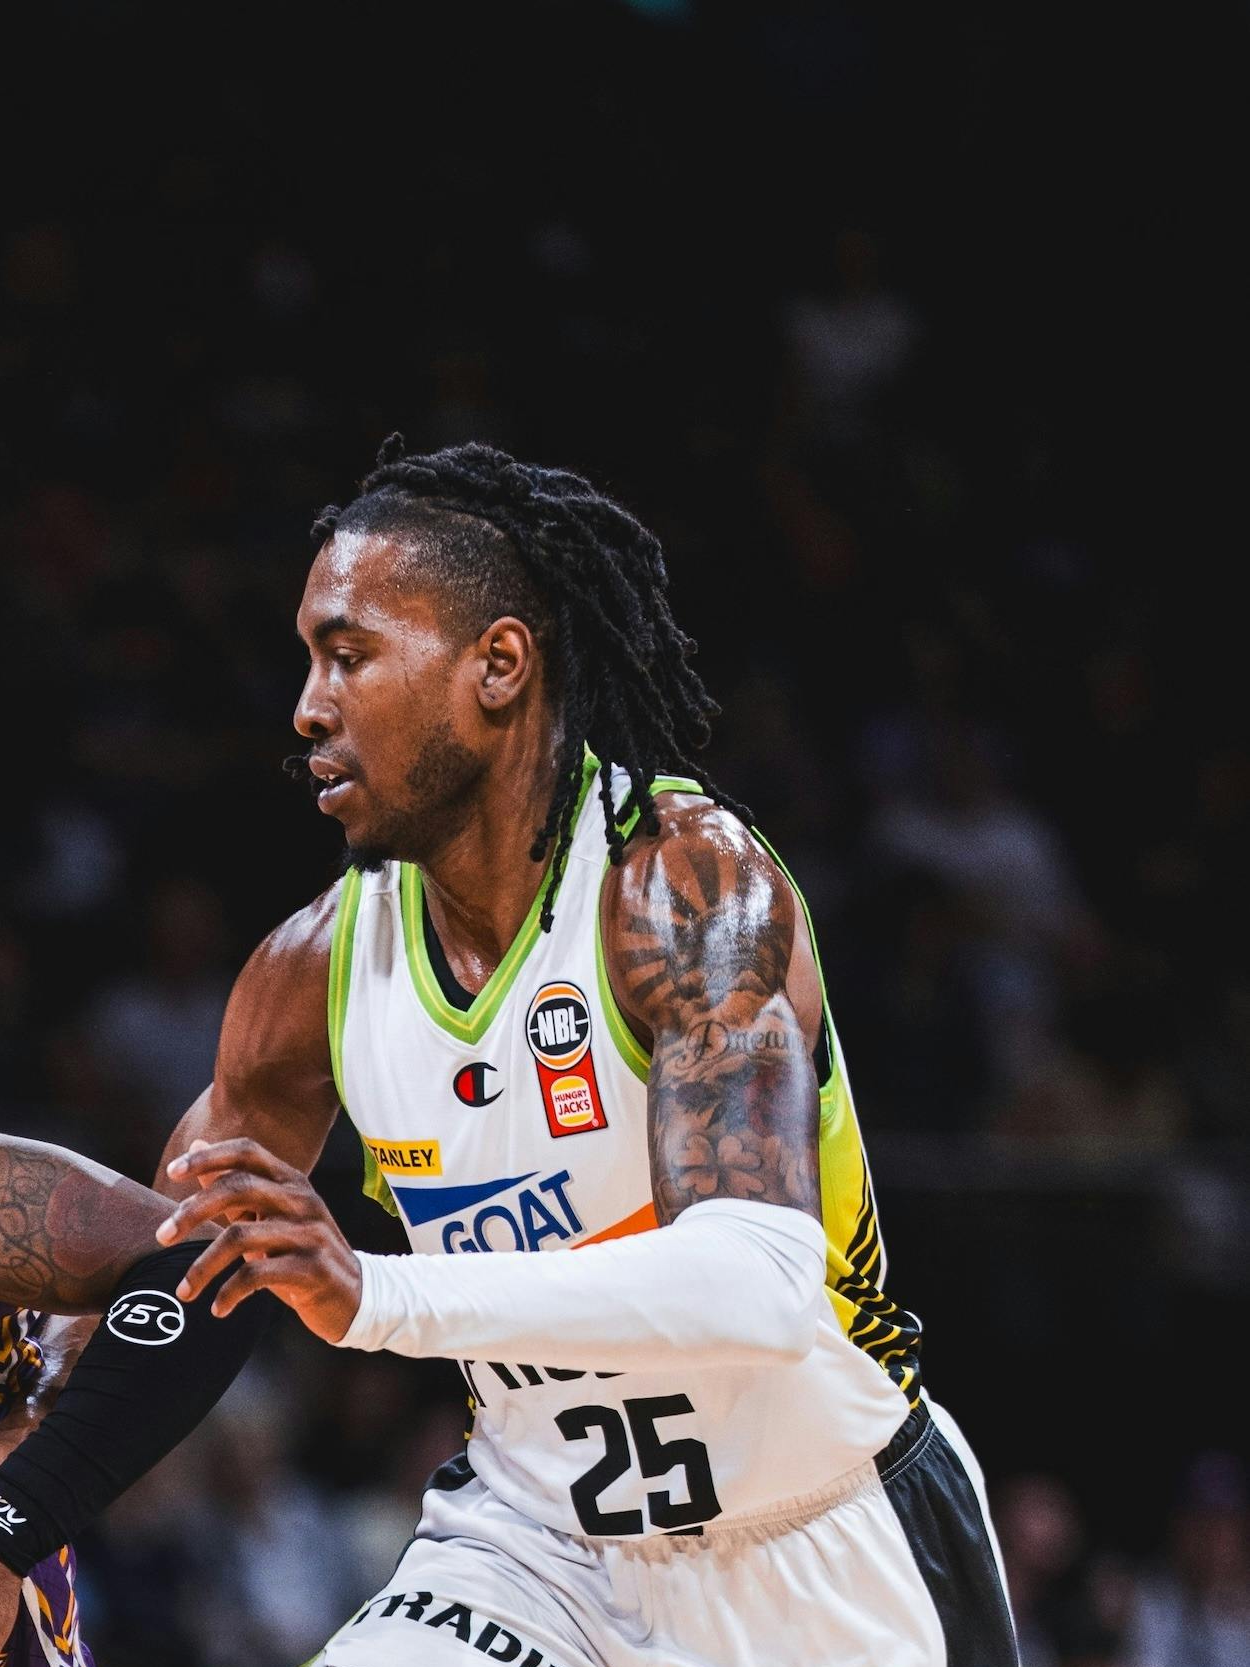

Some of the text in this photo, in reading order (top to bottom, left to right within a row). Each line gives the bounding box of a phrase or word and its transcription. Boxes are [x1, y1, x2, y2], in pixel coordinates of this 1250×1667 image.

[537, 1006, 581, 1047] NBL
[554, 1089, 587, 1103] HUNGRY
[442, 1169, 583, 1254] GOAT
[554, 1393, 722, 1536] 25
